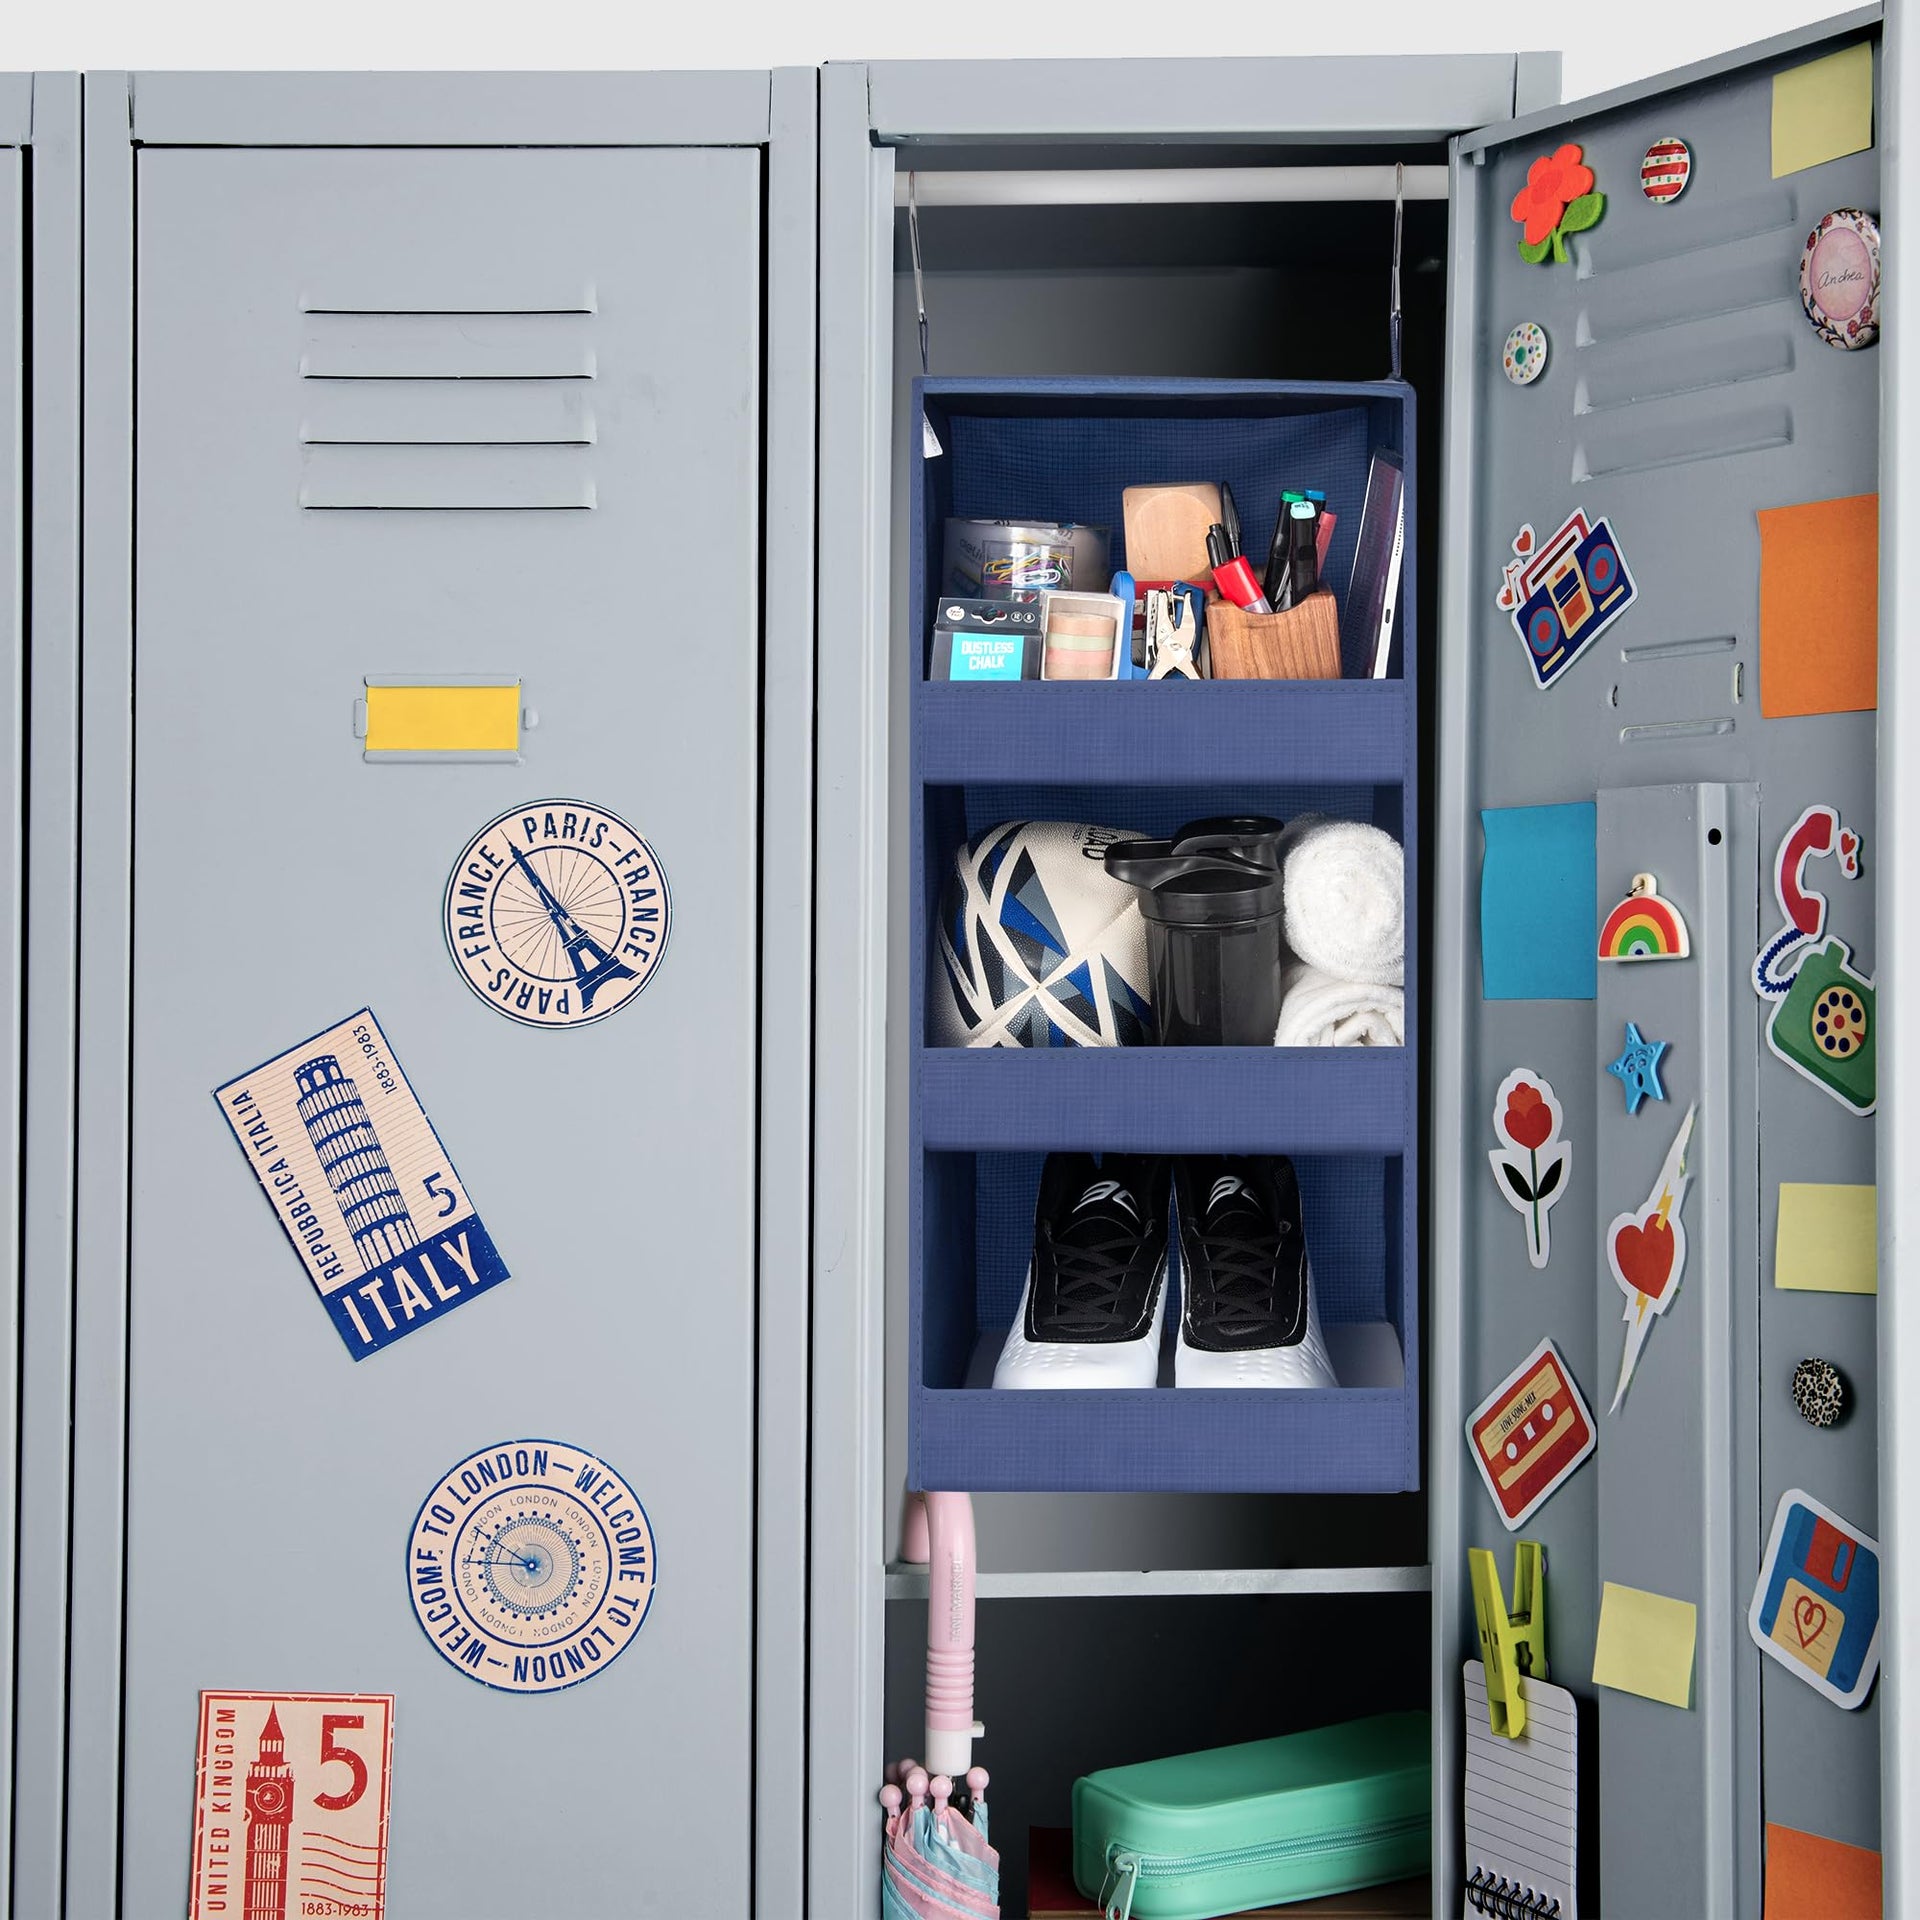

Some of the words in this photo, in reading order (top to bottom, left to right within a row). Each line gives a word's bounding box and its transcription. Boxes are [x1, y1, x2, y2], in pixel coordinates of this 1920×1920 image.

[961, 640, 1014, 655] DUSTLESS
[968, 655, 1005, 671] CHALK
[352, 1024, 398, 1095] 1883-1983
[231, 1089, 279, 1156] ITALIA
[422, 1172, 457, 1217] 5
[267, 1157, 344, 1281] REPUBBLICA
[342, 1231, 480, 1344] ITALY
[422, 1504, 455, 1536] TO
[510, 1495, 558, 1508] LONDON
[564, 1507, 598, 1548] LONDON
[606, 1594, 640, 1628] TO
[212, 1709, 235, 1813] KINGDOM
[313, 1715, 368, 1811] 5
[207, 1827, 230, 1911] UNITED
[301, 1902, 369, 1917] 1883-1983
